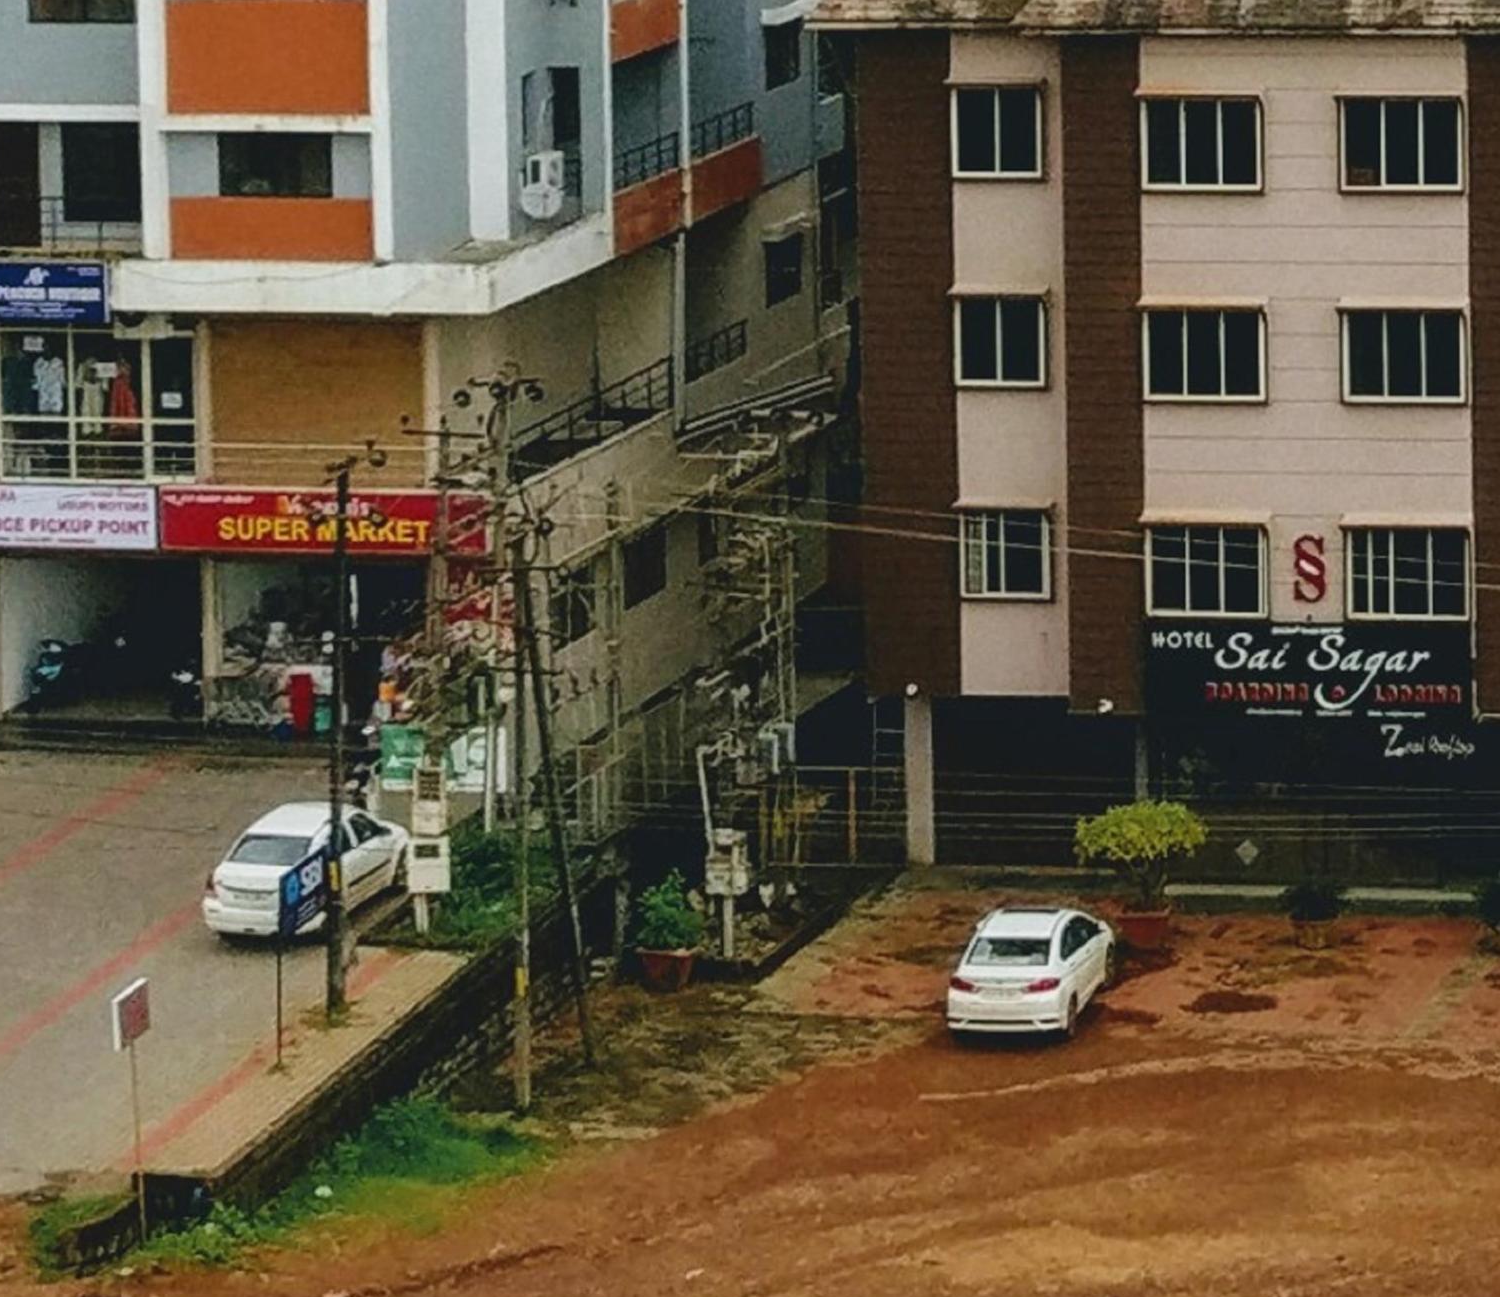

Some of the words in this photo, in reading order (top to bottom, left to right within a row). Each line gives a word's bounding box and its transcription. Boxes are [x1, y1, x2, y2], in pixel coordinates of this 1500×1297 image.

[30, 517, 93, 534] PICKUP
[98, 520, 149, 535] POINT
[218, 516, 310, 541] SUPER
[316, 519, 430, 544] MARKET
[1152, 631, 1214, 648] HOTEL
[1214, 632, 1290, 671] Sai
[1306, 633, 1431, 710] Sagar
